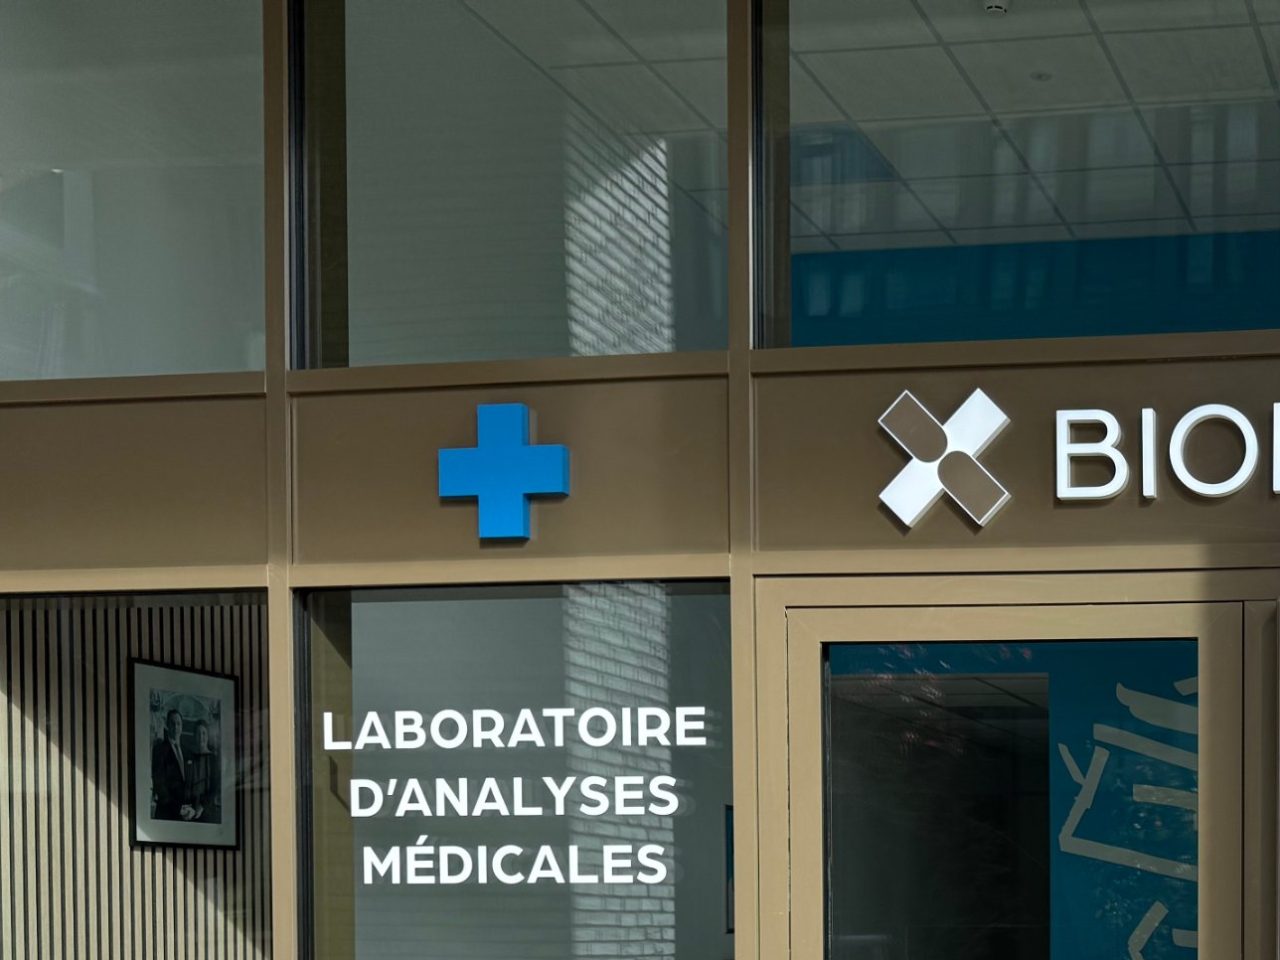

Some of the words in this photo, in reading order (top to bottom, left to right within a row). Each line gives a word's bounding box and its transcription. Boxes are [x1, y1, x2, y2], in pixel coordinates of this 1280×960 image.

[322, 706, 707, 751] LABORATOIRE
[349, 775, 679, 818] D'ANALYSES
[363, 835, 667, 885] MÉDICALES
